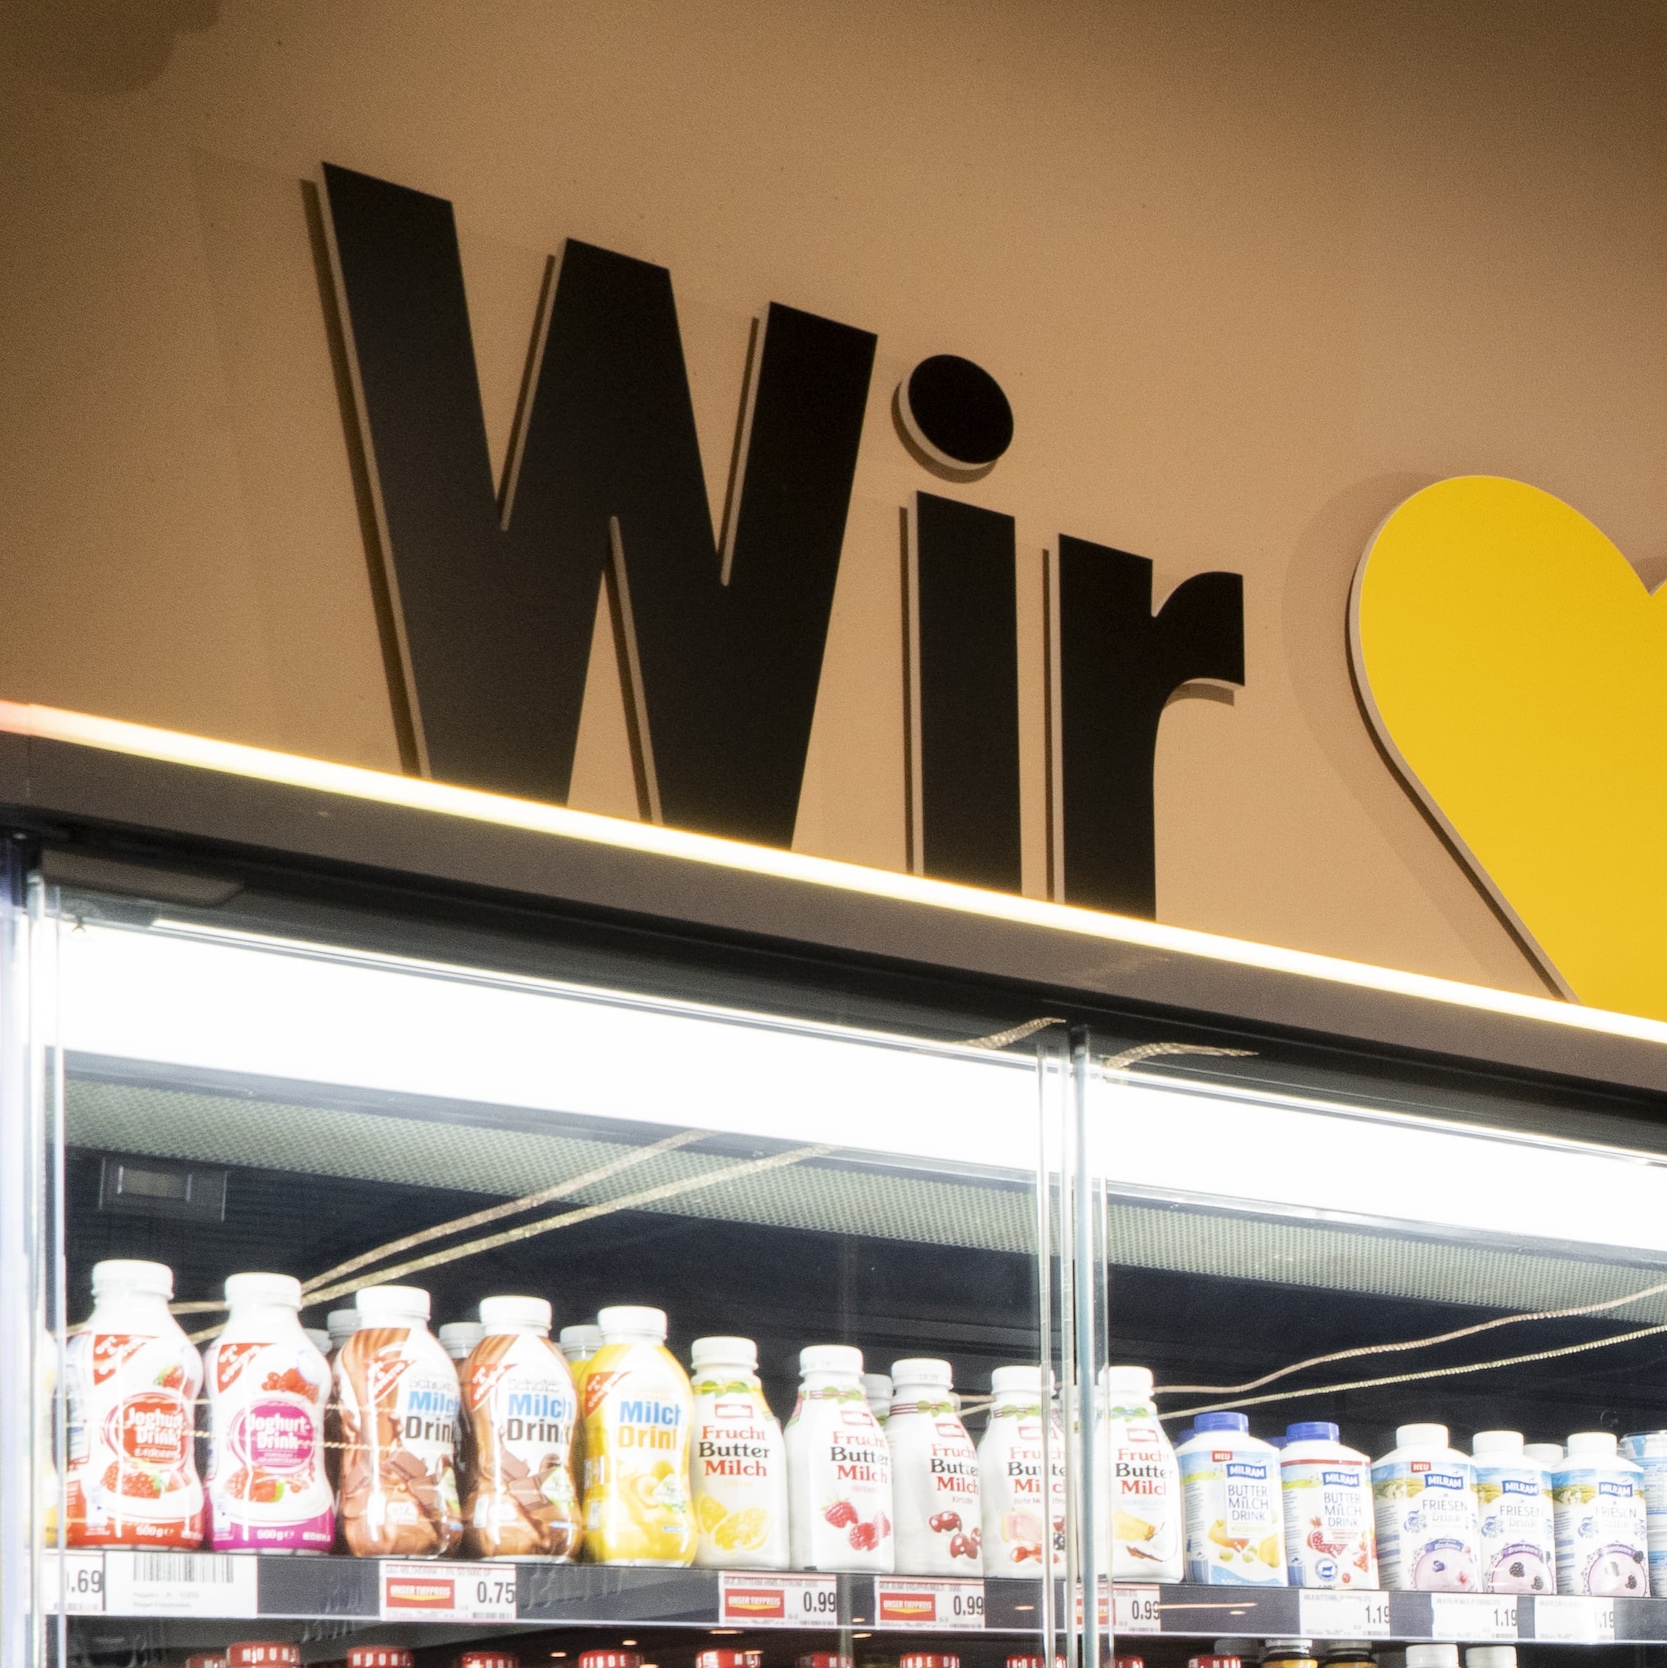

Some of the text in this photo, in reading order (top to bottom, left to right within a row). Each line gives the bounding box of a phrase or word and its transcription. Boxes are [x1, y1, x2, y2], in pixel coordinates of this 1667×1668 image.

[318, 160, 1245, 925] Wir
[702, 1423, 767, 1442] Frucht
[698, 1441, 770, 1460] Butter
[1214, 1452, 1230, 1461] NEU
[704, 1458, 768, 1478] Milch
[1228, 1464, 1265, 1479] MILRAM
[1324, 1473, 1359, 1486] MILRAM
[1427, 1475, 1464, 1489] MILRAM
[1503, 1480, 1537, 1494] MILRAM
[1227, 1484, 1269, 1499] BUTTER
[1422, 1499, 1468, 1512] FRIESEN
[1231, 1508, 1267, 1522] DRINK
[476, 1581, 516, 1604] 0.75
[803, 1591, 837, 1614] 0.99
[953, 1595, 984, 1617] 0.99
[1365, 1605, 1390, 1625] 1.19
